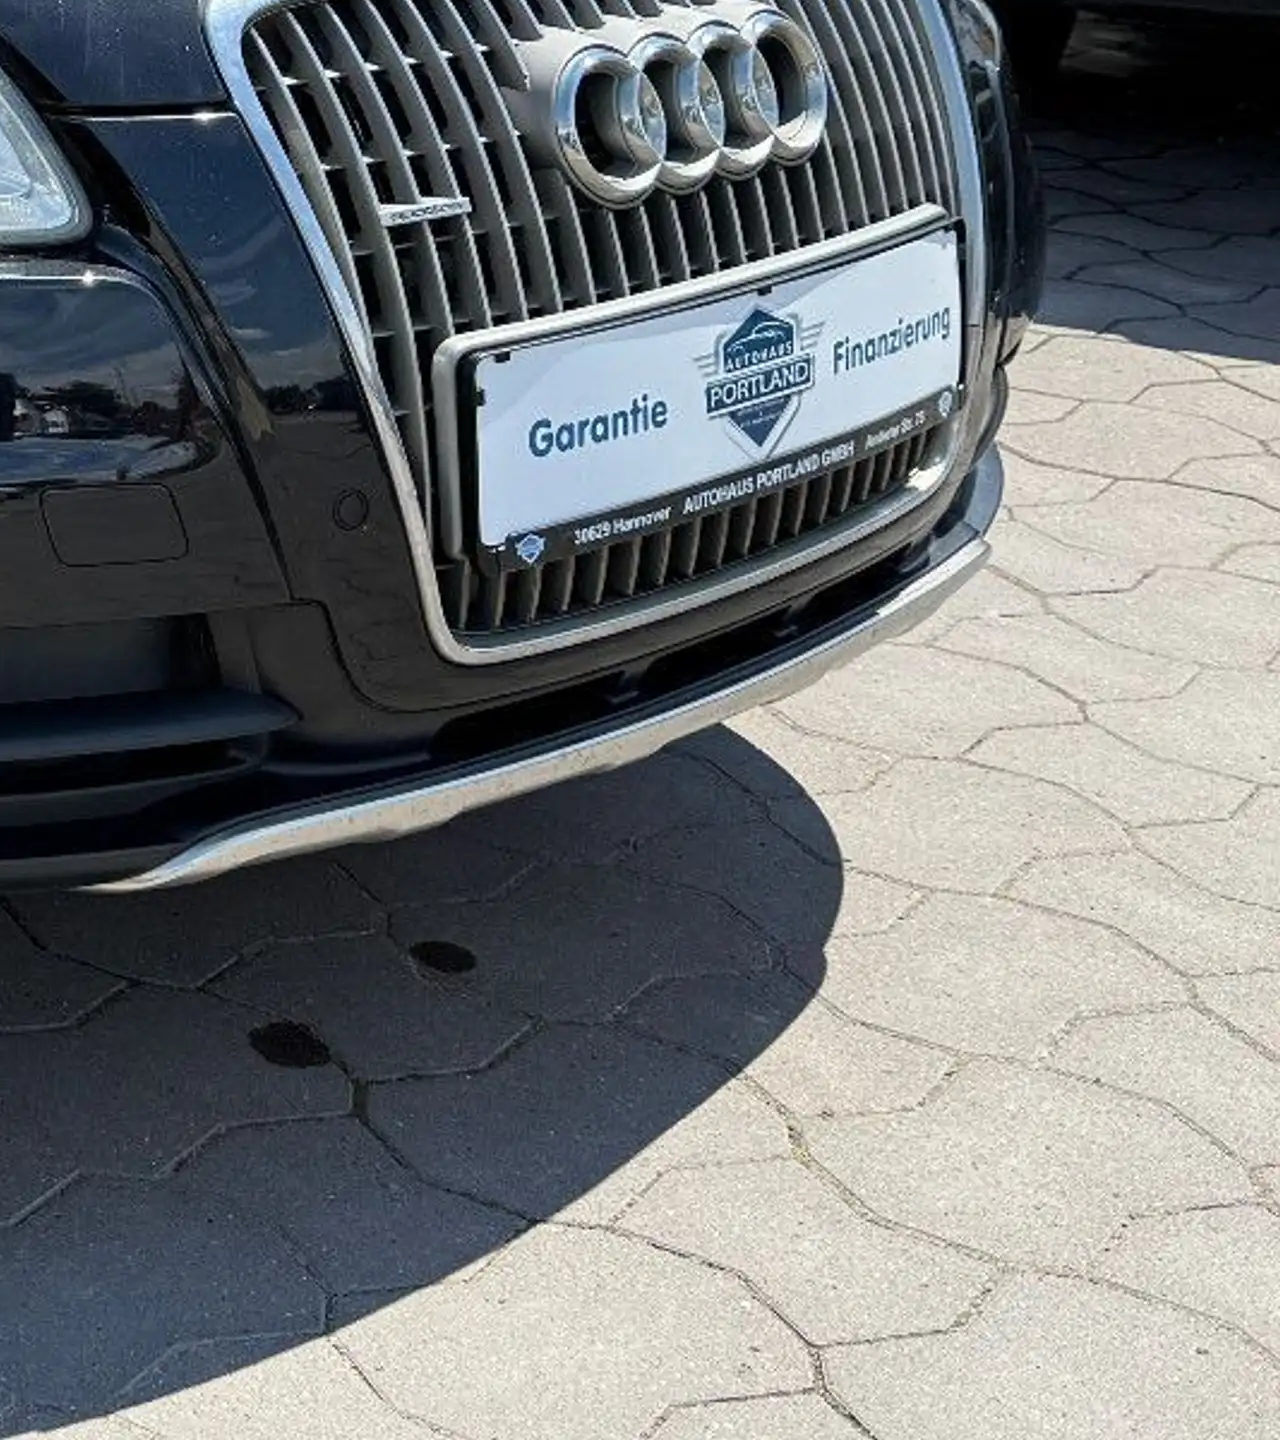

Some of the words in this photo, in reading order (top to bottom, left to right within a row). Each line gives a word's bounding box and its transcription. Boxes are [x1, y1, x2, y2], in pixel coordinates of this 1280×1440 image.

[726, 341, 792, 372] AUTOHAUS
[833, 307, 950, 374] Finanzierung
[709, 361, 809, 409] PORTLAND
[528, 393, 668, 457] Garantie
[682, 474, 754, 515] AUTOHAUS
[756, 452, 819, 490] PORTLAND
